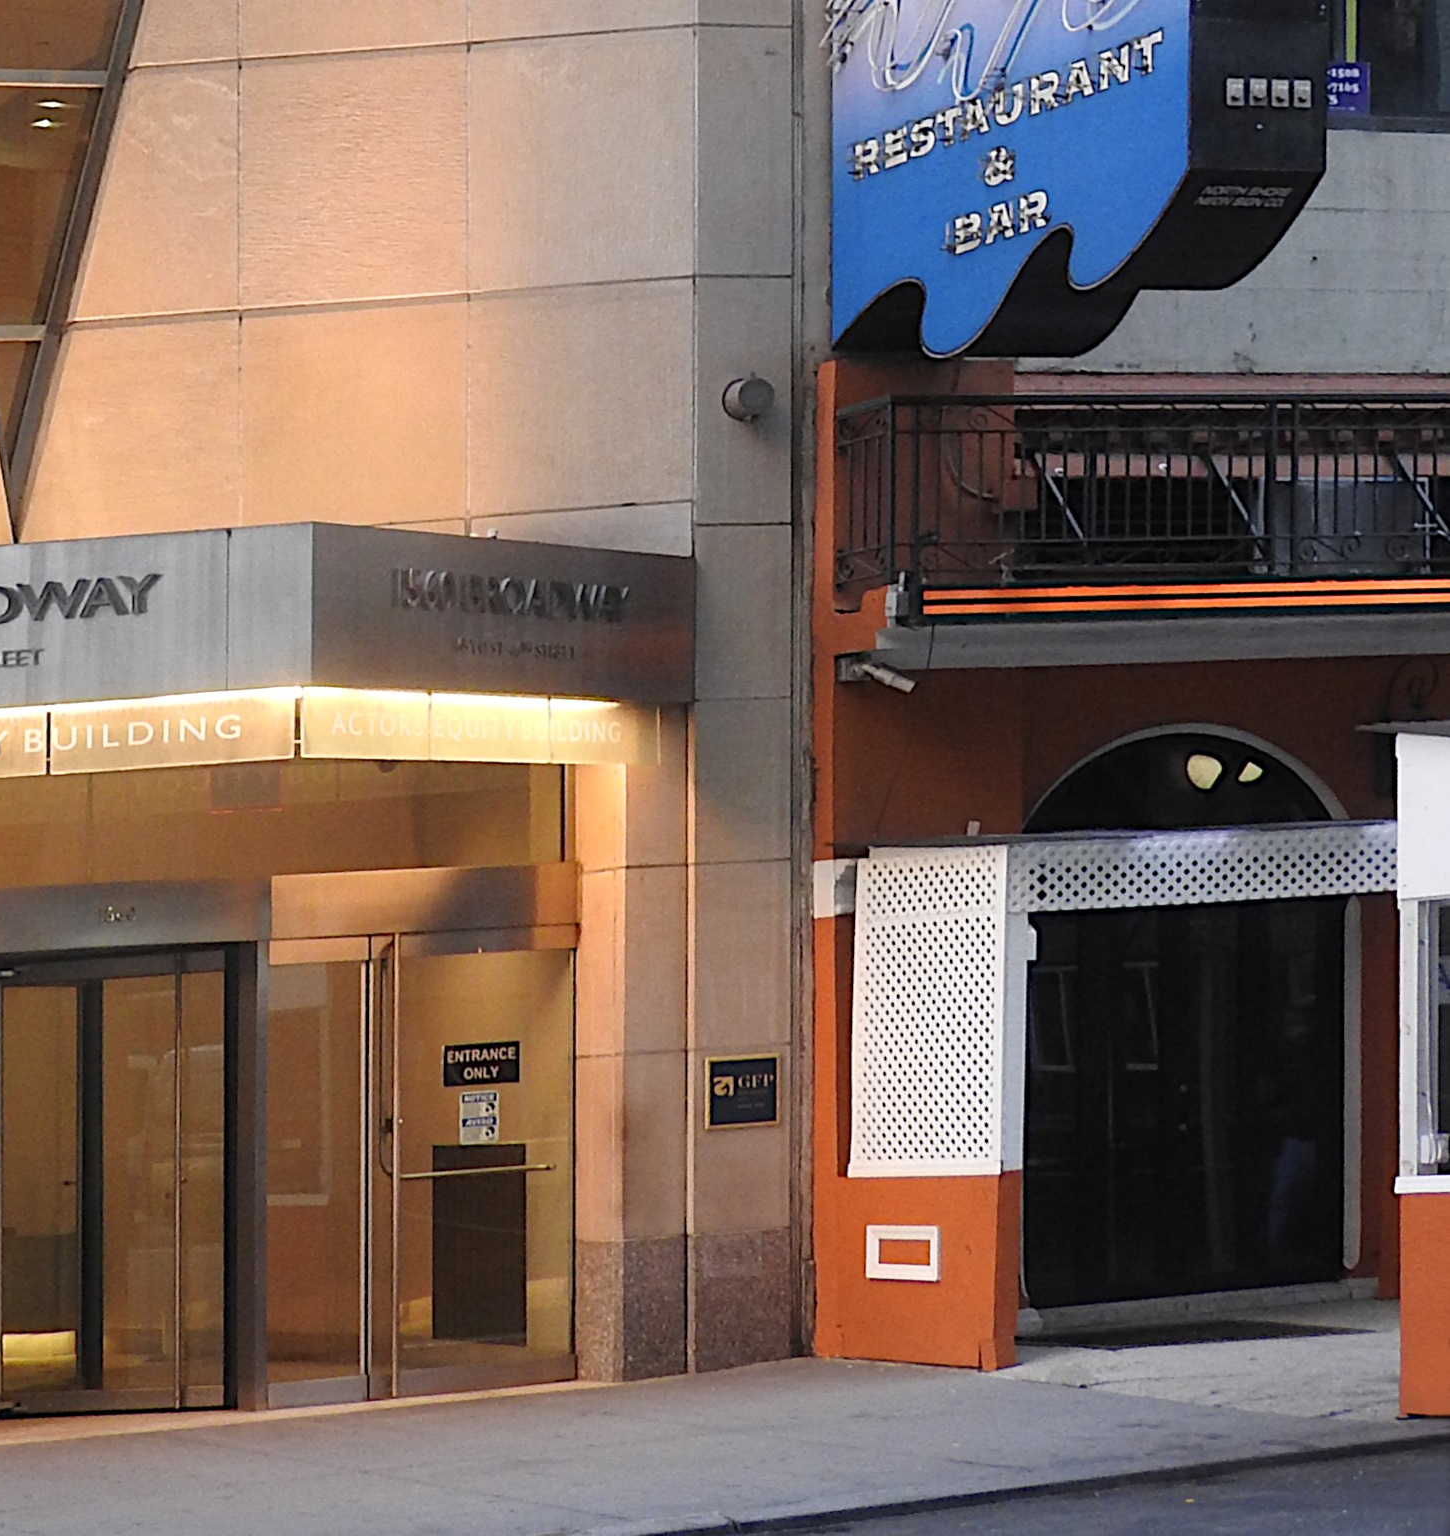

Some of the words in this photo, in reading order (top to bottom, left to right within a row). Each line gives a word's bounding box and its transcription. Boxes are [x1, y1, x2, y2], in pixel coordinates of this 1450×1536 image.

[851, 29, 1164, 180] RESTAURANT
[981, 145, 1016, 188] &
[950, 190, 1051, 256] BAR
[25, 714, 243, 753] BUILDING
[447, 1046, 517, 1064] ENTRANCE
[463, 1065, 500, 1080] ONLY
